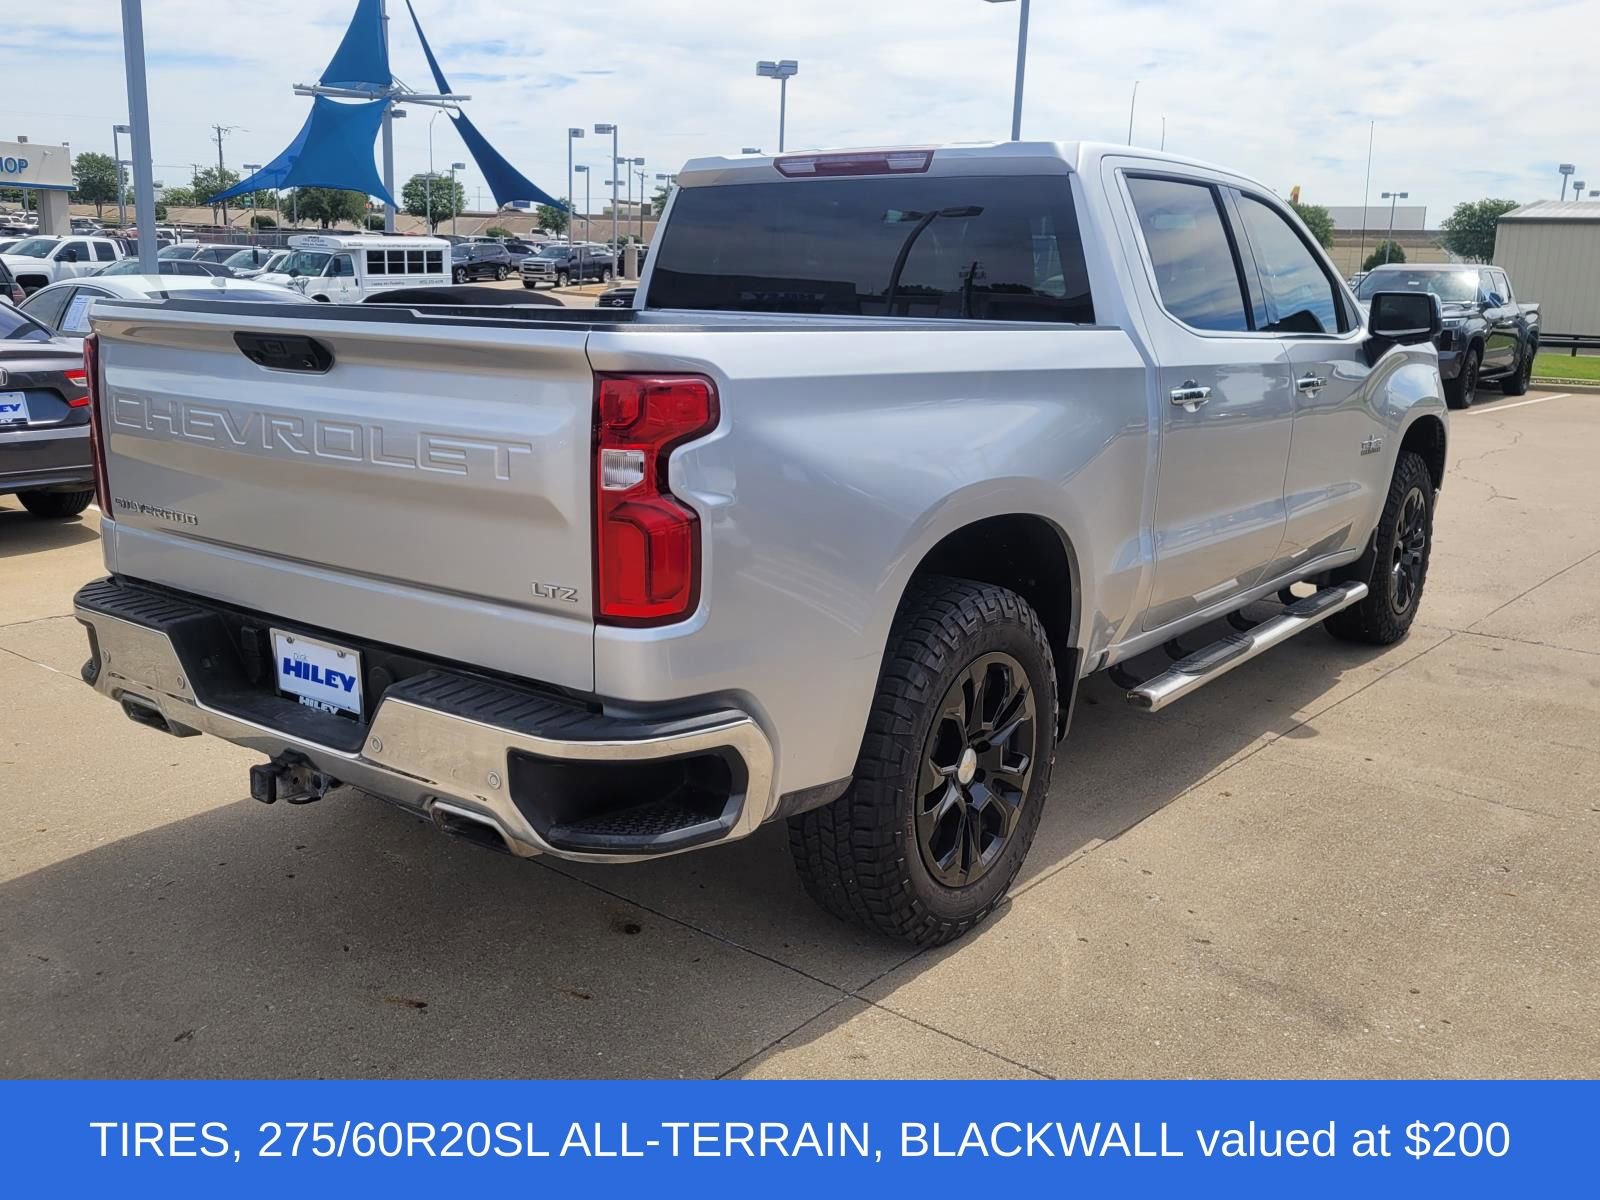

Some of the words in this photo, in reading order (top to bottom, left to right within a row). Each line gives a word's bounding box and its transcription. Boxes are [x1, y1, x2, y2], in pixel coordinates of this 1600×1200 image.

[112, 393, 533, 481] CHEVROLET
[114, 497, 198, 526] SILVERADO
[531, 582, 578, 602] LTZ
[283, 657, 356, 693] HILEY
[299, 695, 339, 714] HILEY
